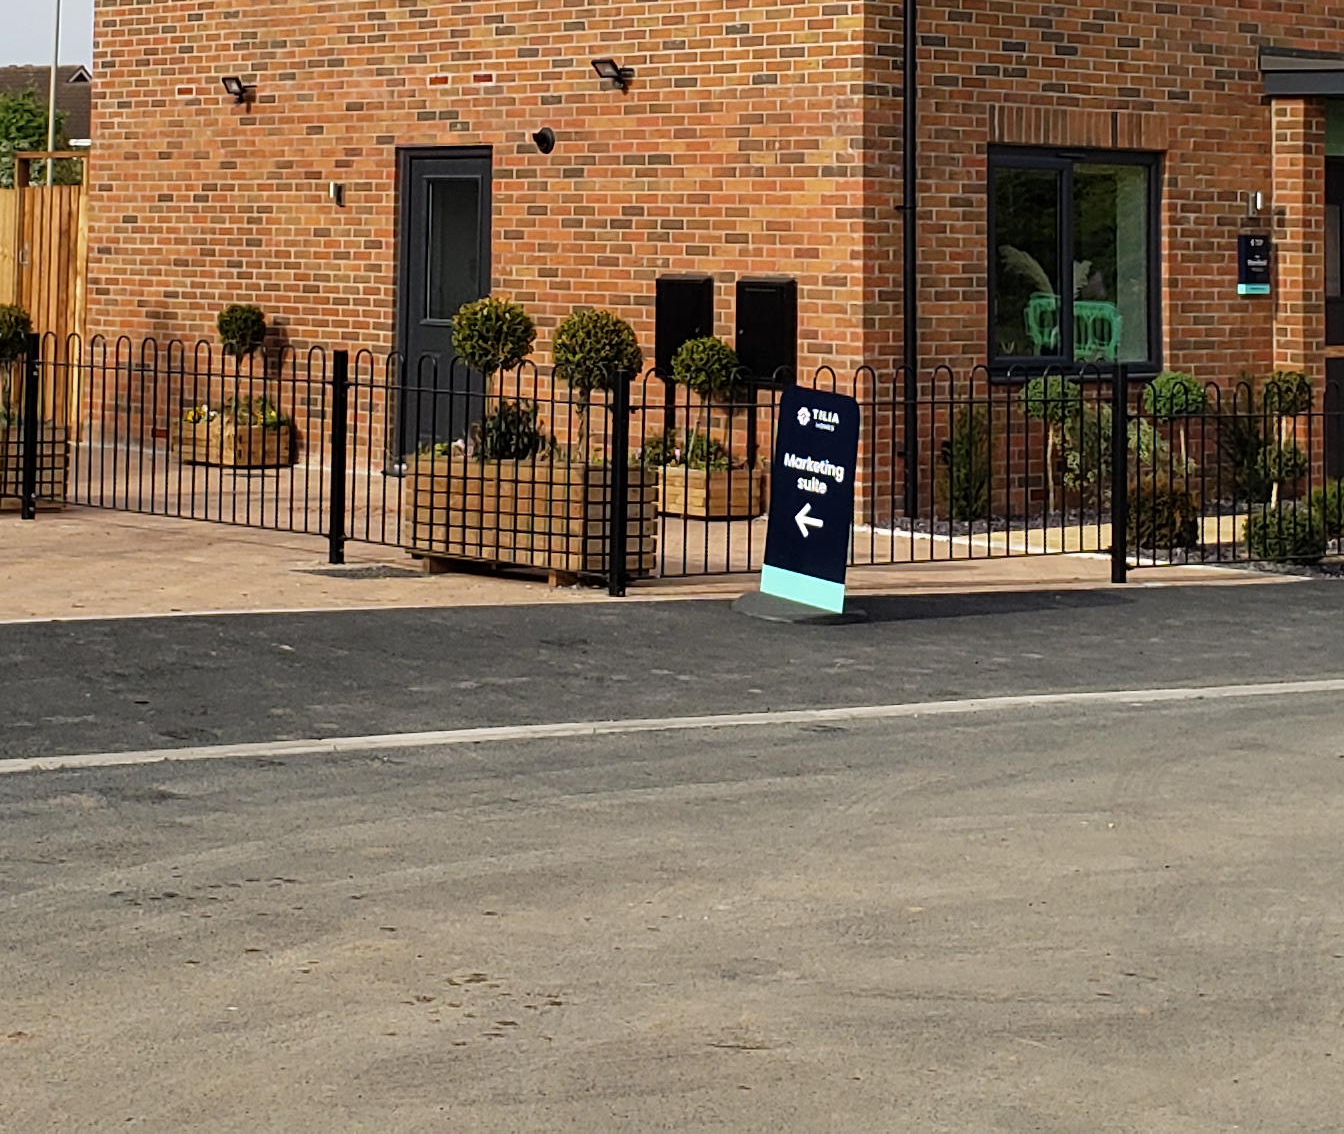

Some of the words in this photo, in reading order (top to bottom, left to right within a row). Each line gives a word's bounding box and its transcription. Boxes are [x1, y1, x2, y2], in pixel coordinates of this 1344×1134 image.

[811, 408, 840, 425] TILIA
[783, 452, 845, 483] Marketing
[796, 476, 828, 495] suite
